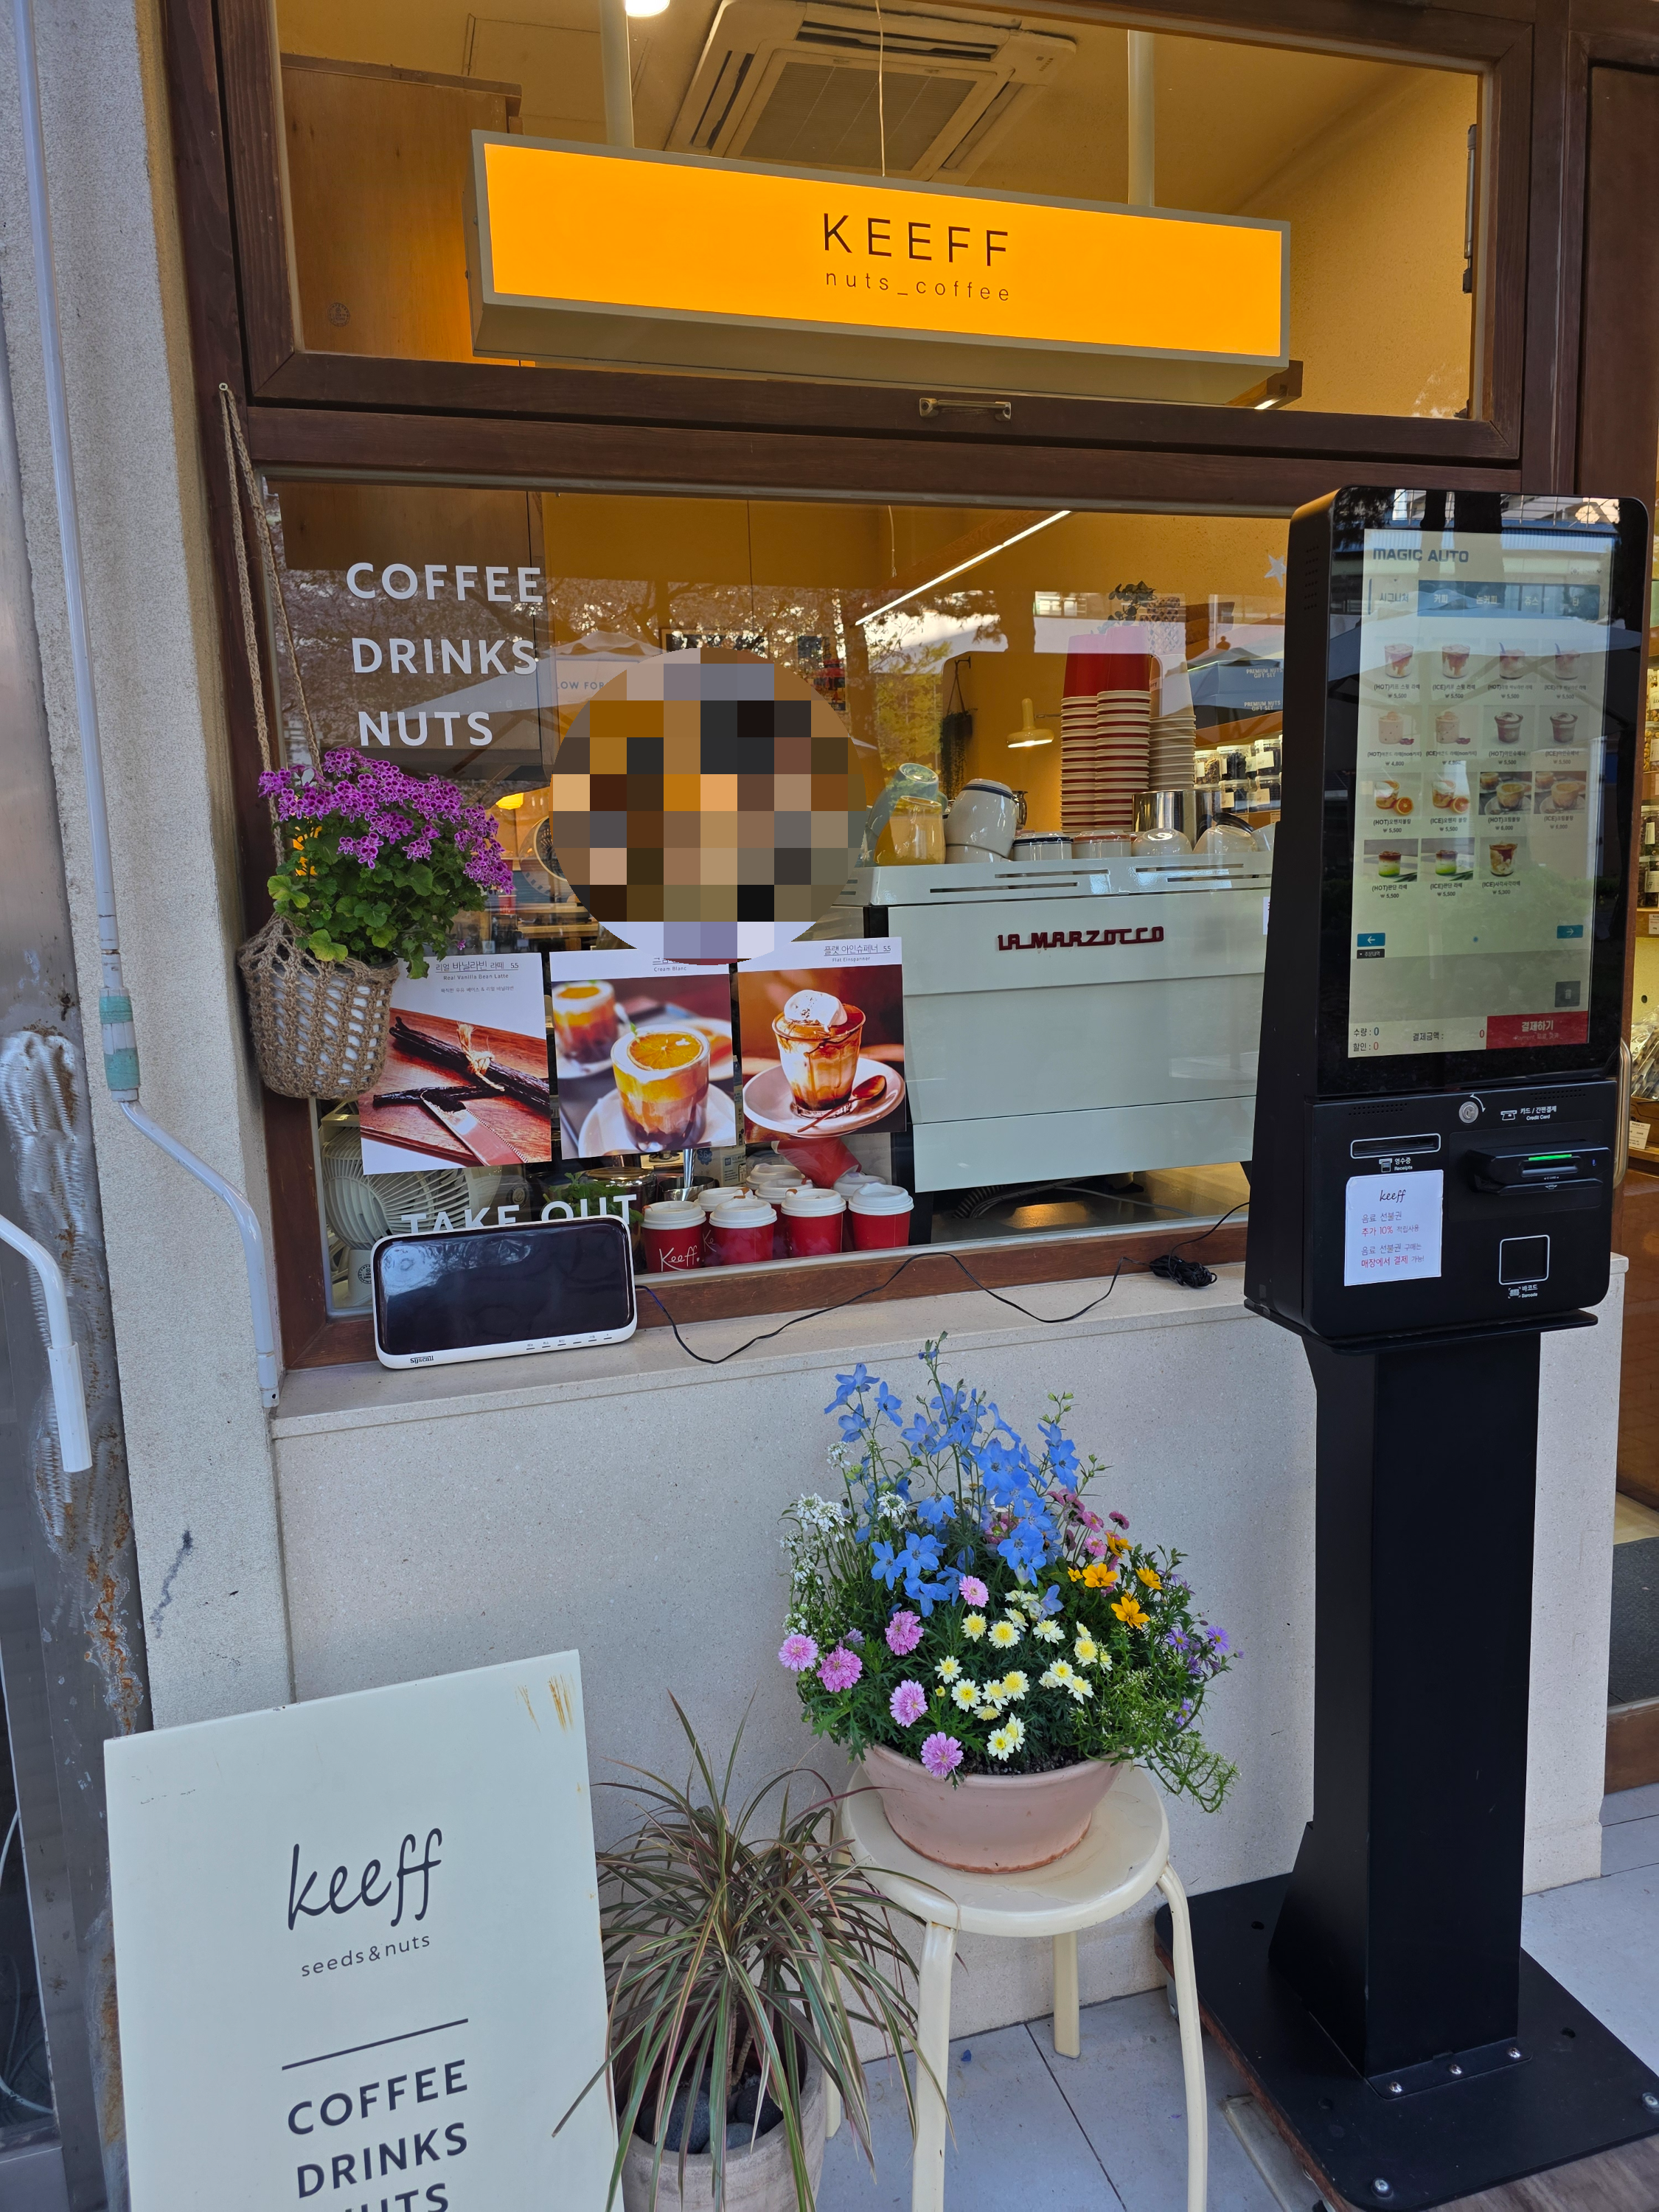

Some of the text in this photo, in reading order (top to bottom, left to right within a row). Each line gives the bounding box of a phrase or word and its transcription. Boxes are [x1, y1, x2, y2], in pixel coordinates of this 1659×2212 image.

[824, 213, 1008, 266] KEEFF
[826, 272, 1009, 302] nuts_coffee
[1373, 548, 1469, 563] MAGIC AUTO
[346, 562, 543, 602] COFFEE
[1433, 594, 1448, 603] 커피
[352, 638, 538, 675] DRINKS
[557, 681, 609, 689] OW FOR
[358, 711, 493, 746] NUTS
[824, 945, 839, 956] 플랫
[841, 944, 878, 954] 아인슈페너
[435, 963, 450, 972] 리얼
[452, 960, 487, 971] 바닐라빈
[490, 961, 504, 970] 라떼
[1354, 1028, 1368, 1037] 수량
[1374, 1027, 1380, 1036] 0
[1521, 1020, 1554, 1032] 결제하기
[1413, 1032, 1440, 1042] 결제금액
[1479, 1029, 1485, 1038] 0
[1353, 1042, 1367, 1051] 할인
[1373, 1041, 1379, 1051] 0
[1535, 1105, 1557, 1113] 간편결제
[1394, 1157, 1411, 1165] 영수증
[1380, 1189, 1406, 1203] keeff
[1361, 1211, 1402, 1223] 음료 선불권
[1361, 1224, 1419, 1237] 추가 10% 적립사용
[1361, 1242, 1422, 1256] 음료 선불권 구매는
[1361, 1255, 1425, 1268] 매장에서 결제 가능!
[1521, 1284, 1538, 1292] 바코드
[410, 1355, 434, 1364] Syscall
[288, 1828, 442, 1930] keeff
[301, 1934, 431, 1978] seeds&nuts
[288, 2059, 467, 2135] COFFEE
[297, 2122, 467, 2199] DRINKS
